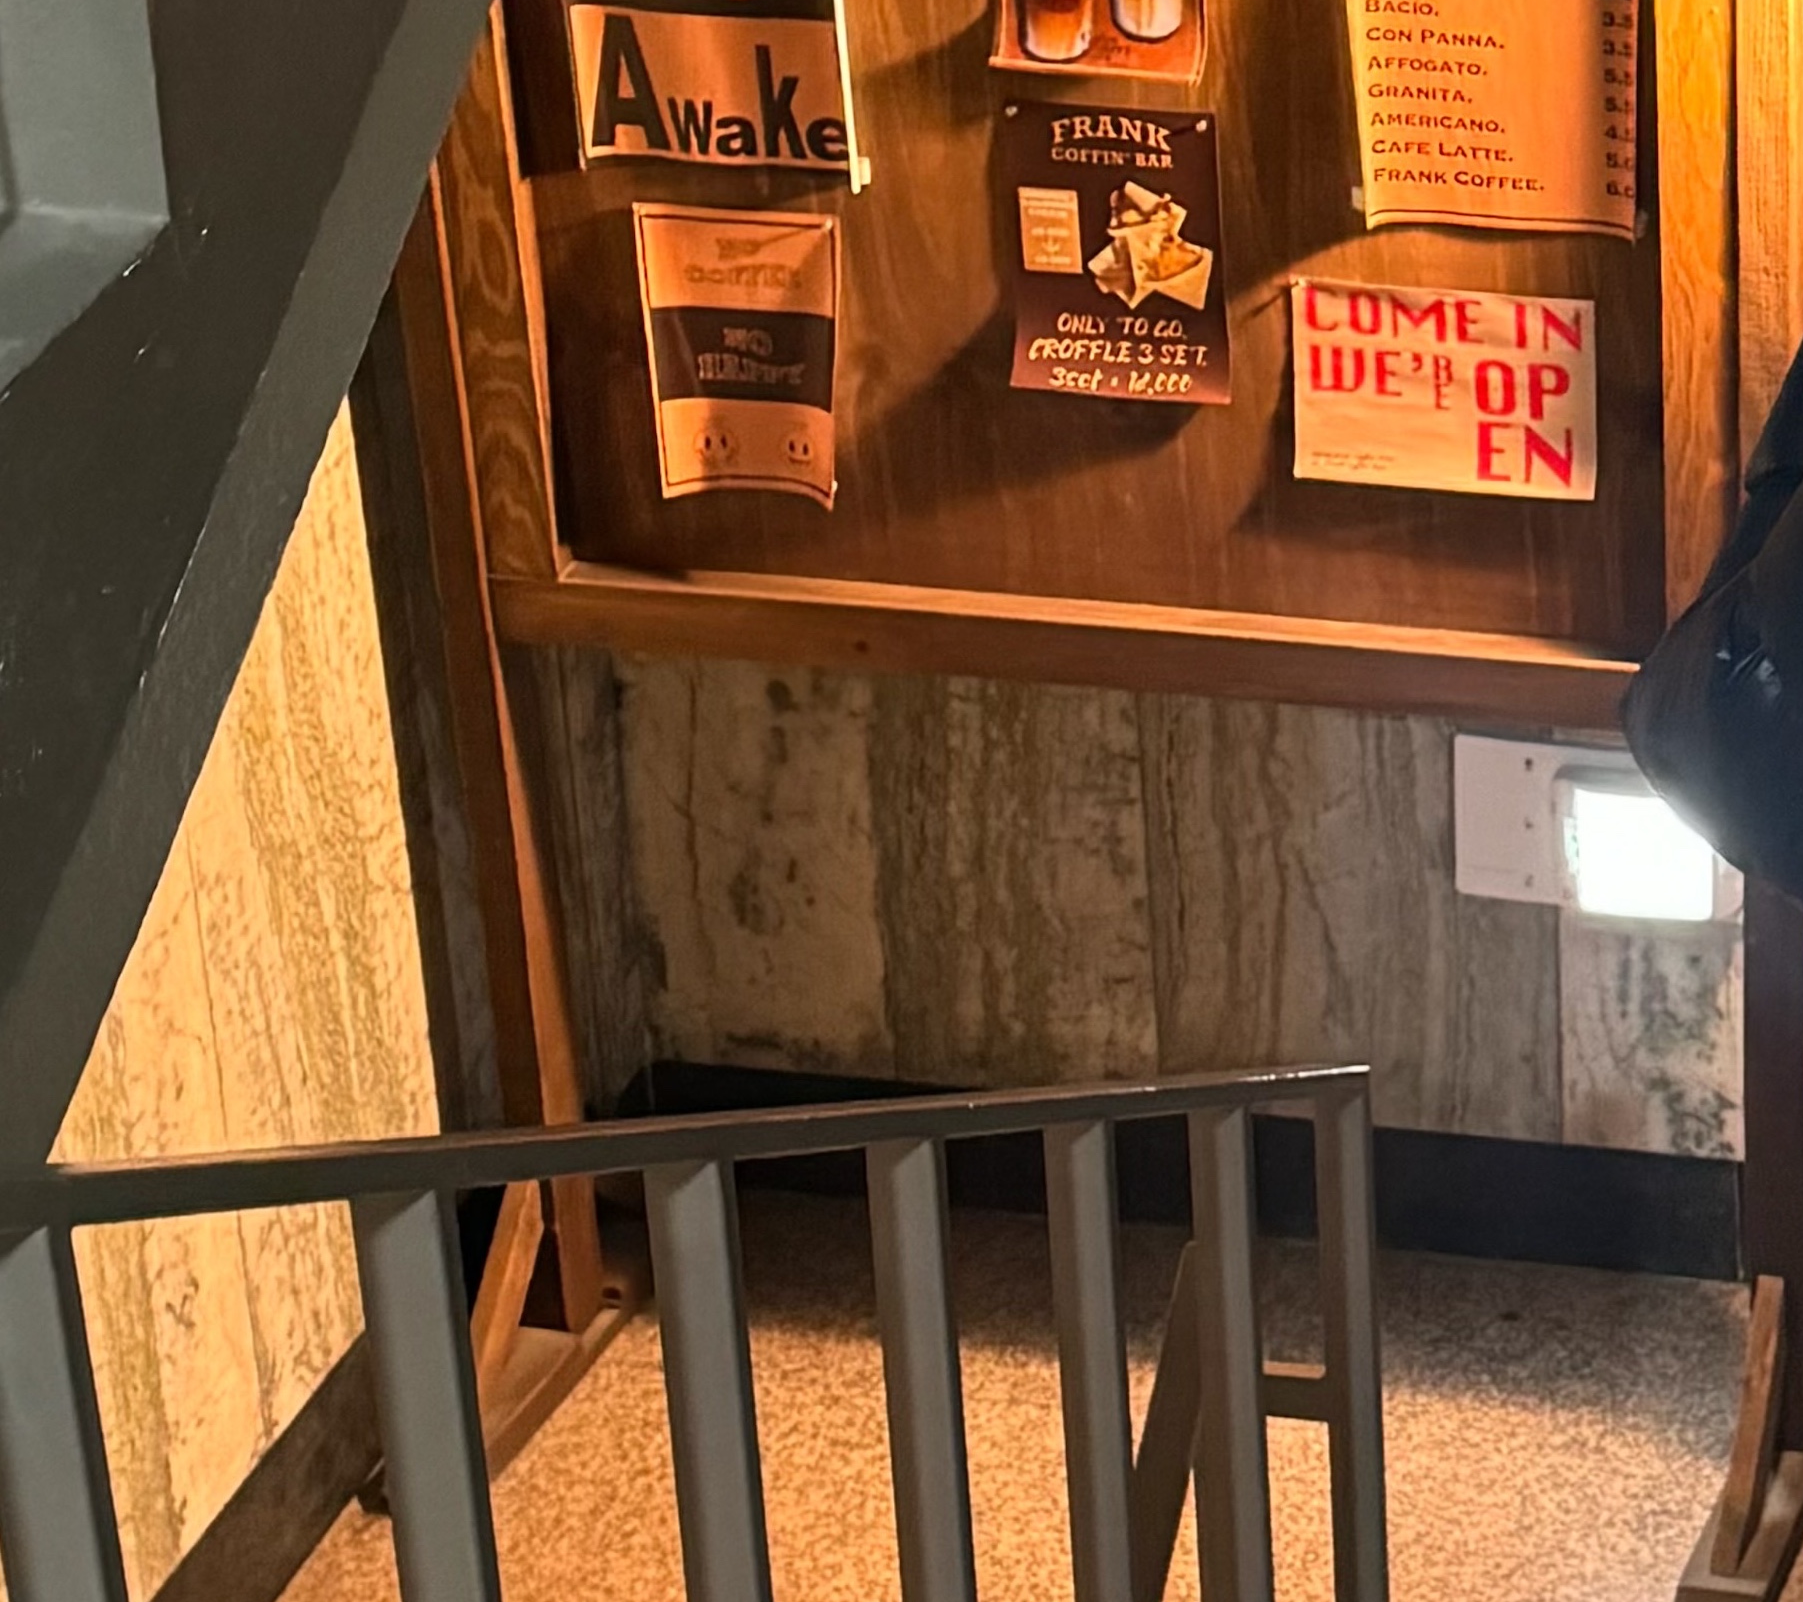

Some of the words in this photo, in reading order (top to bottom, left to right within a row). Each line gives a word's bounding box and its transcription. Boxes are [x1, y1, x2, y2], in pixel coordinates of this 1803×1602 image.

[1365, 26, 1412, 43] CON
[591, 12, 850, 162] Awake
[1051, 115, 1172, 152] FRANK
[1371, 139, 1431, 156] CAFE
[1134, 152, 1174, 169] BAR
[1373, 167, 1447, 185] FRANK
[1057, 311, 1107, 335] ONLY
[1117, 316, 1149, 336] TO
[1513, 302, 1583, 353] IN
[1028, 337, 1133, 363] CROFFLE
[1137, 343, 1154, 365] 3
[1474, 359, 1571, 421] OP
[1476, 420, 1574, 488] EN
